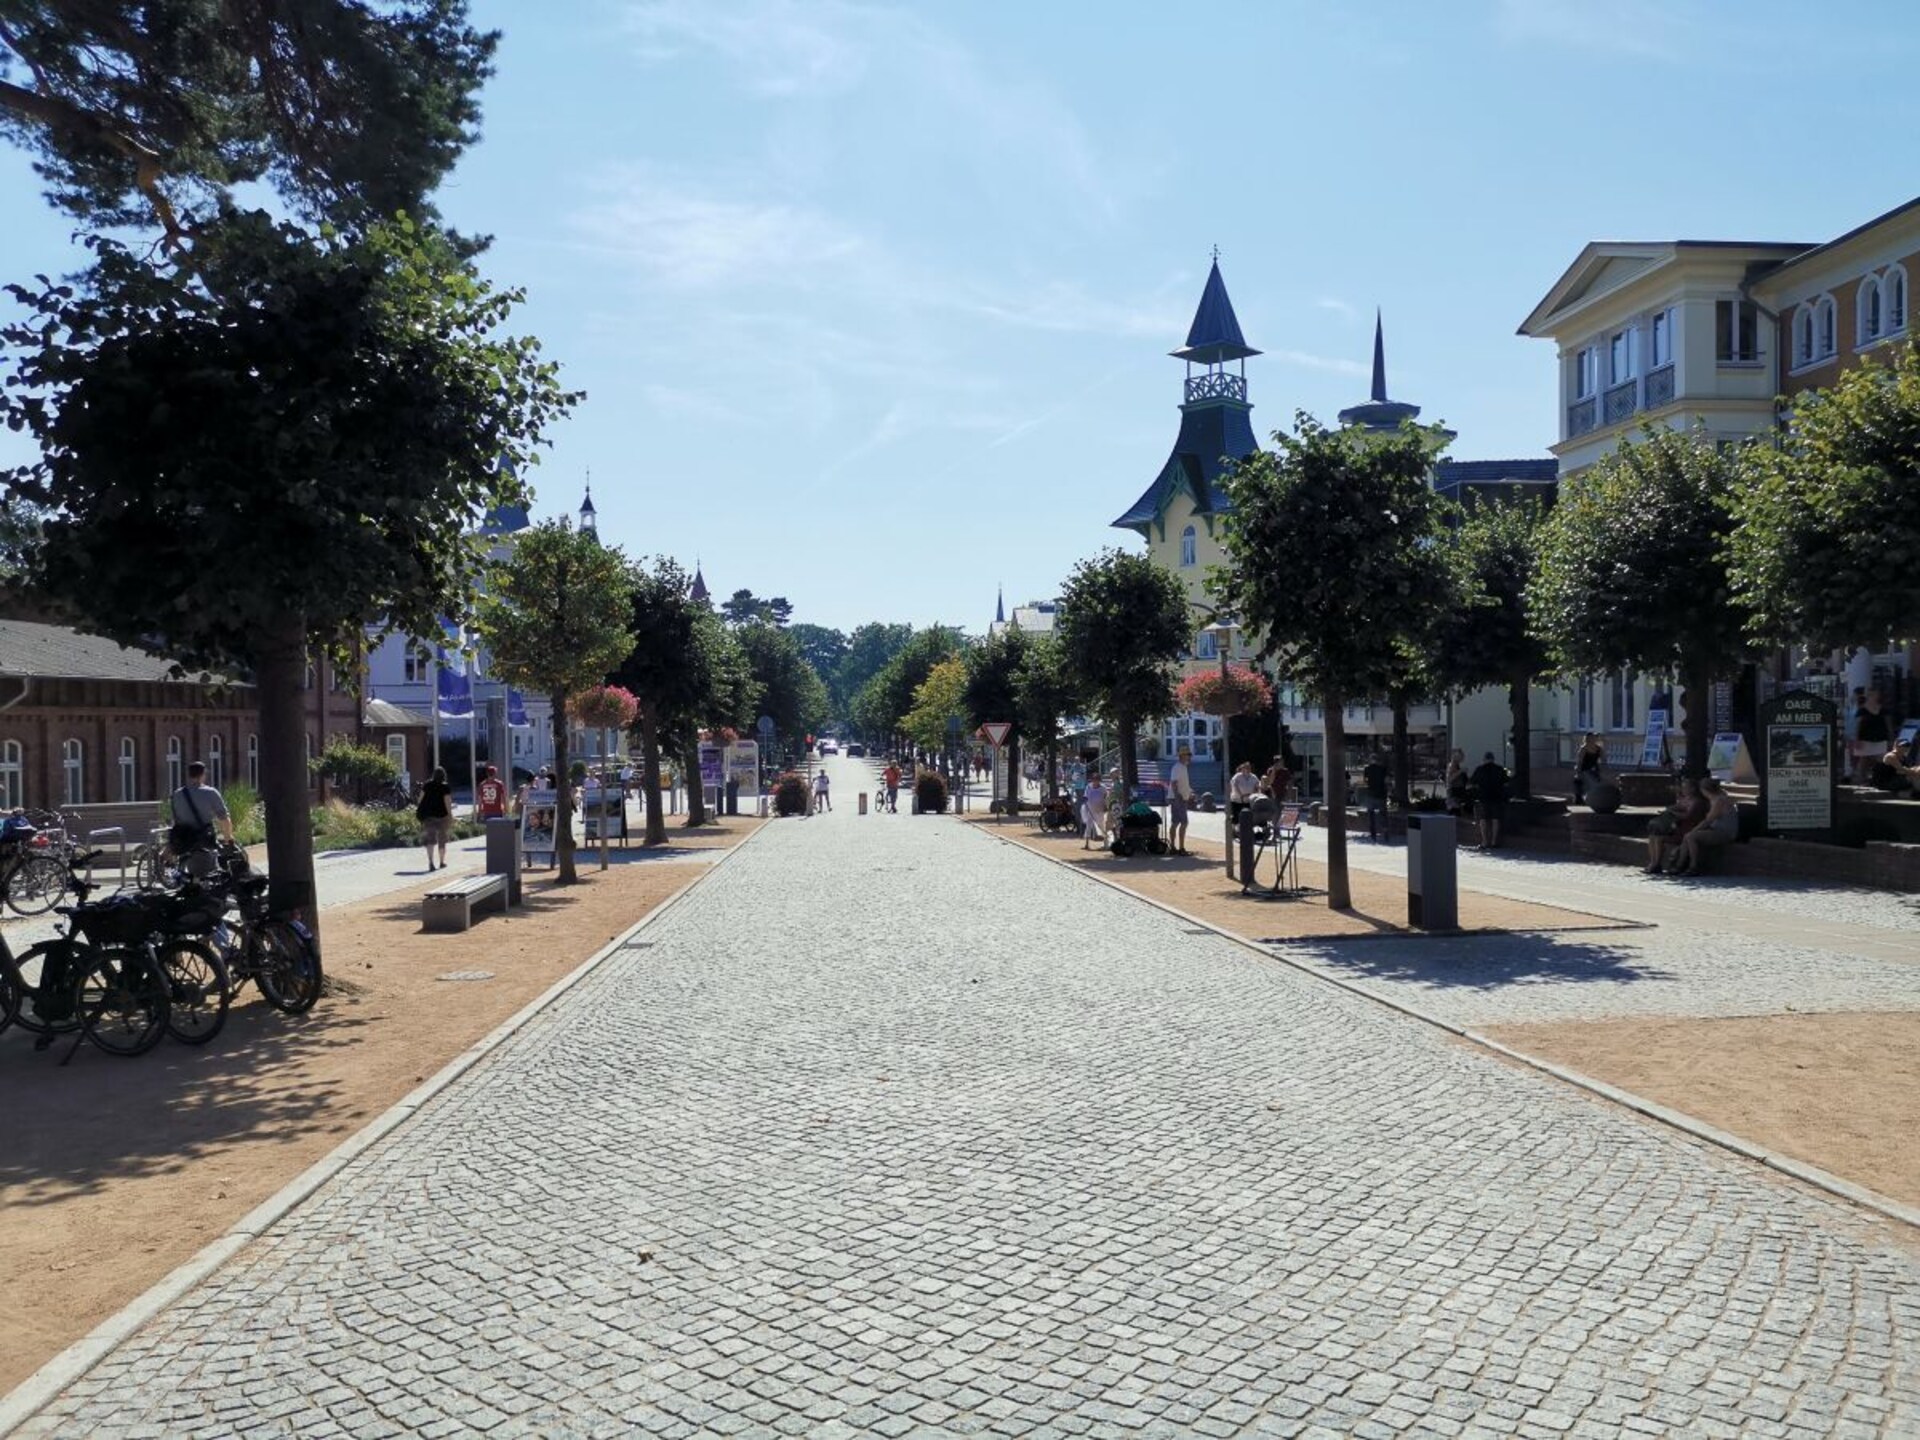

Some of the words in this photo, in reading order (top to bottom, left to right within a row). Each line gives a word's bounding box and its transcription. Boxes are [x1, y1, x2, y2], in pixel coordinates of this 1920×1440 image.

[1785, 701, 1812, 710] OASE
[1776, 713, 1792, 723] AM
[1795, 712, 1822, 723] MEER
[482, 788, 497, 801] 39
